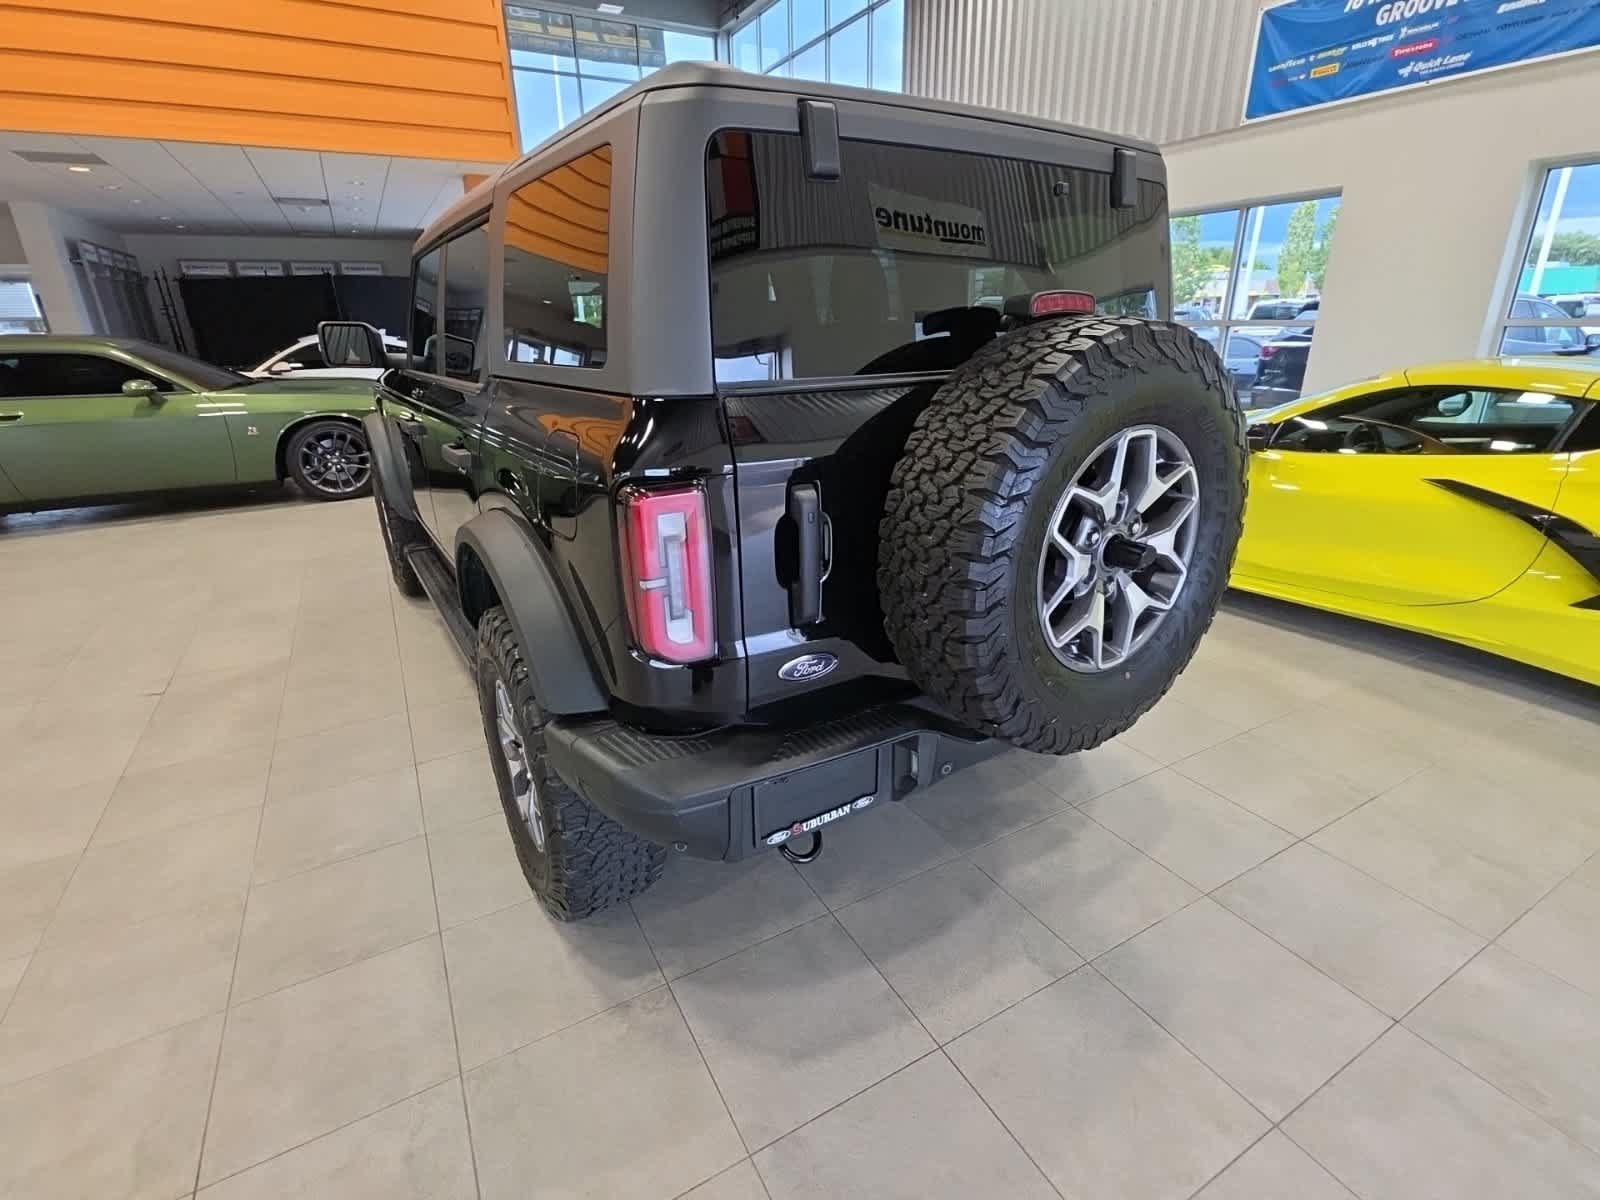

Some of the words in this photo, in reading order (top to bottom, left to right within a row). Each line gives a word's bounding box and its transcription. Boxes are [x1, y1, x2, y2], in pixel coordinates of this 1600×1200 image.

[1376, 0, 1457, 25] GROOV
[793, 659, 825, 677] Ford
[792, 805, 850, 835] SUBURBAN
